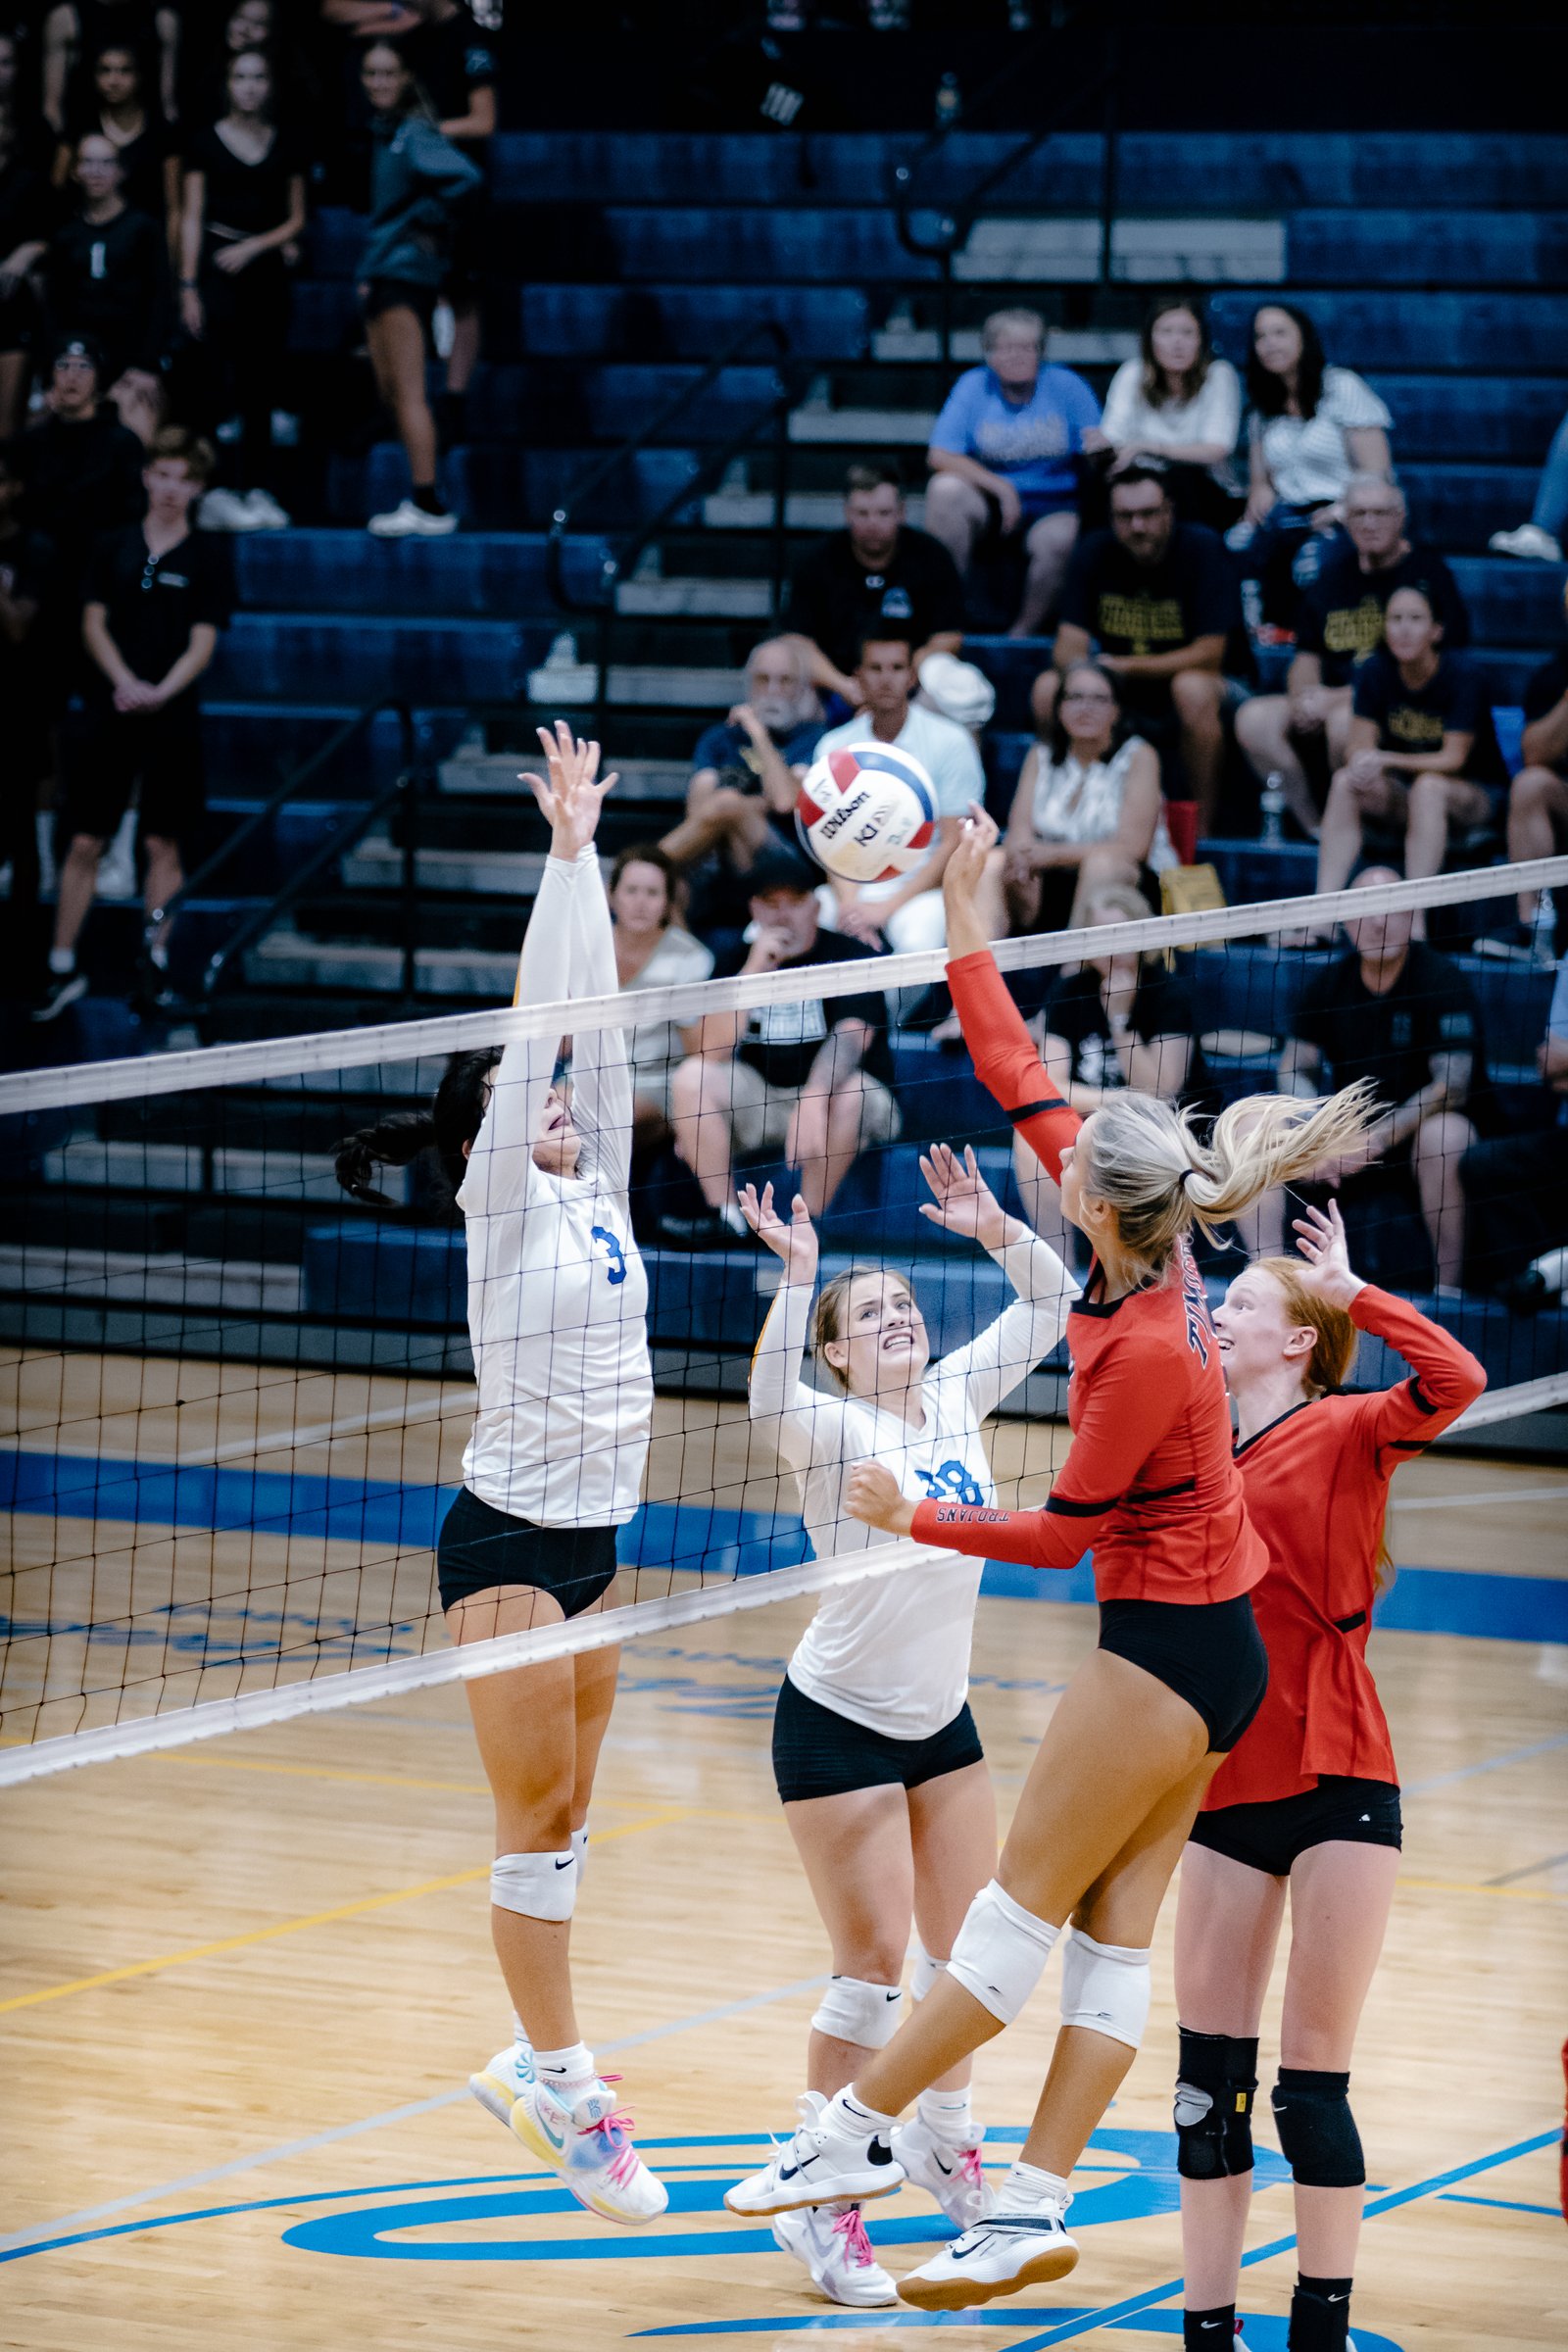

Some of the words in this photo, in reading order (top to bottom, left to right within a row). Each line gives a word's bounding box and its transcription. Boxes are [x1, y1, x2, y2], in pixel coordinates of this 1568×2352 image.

[819, 791, 870, 840] Wilson
[591, 1226, 627, 1286] 3
[937, 1507, 1009, 1524] TROJANS
